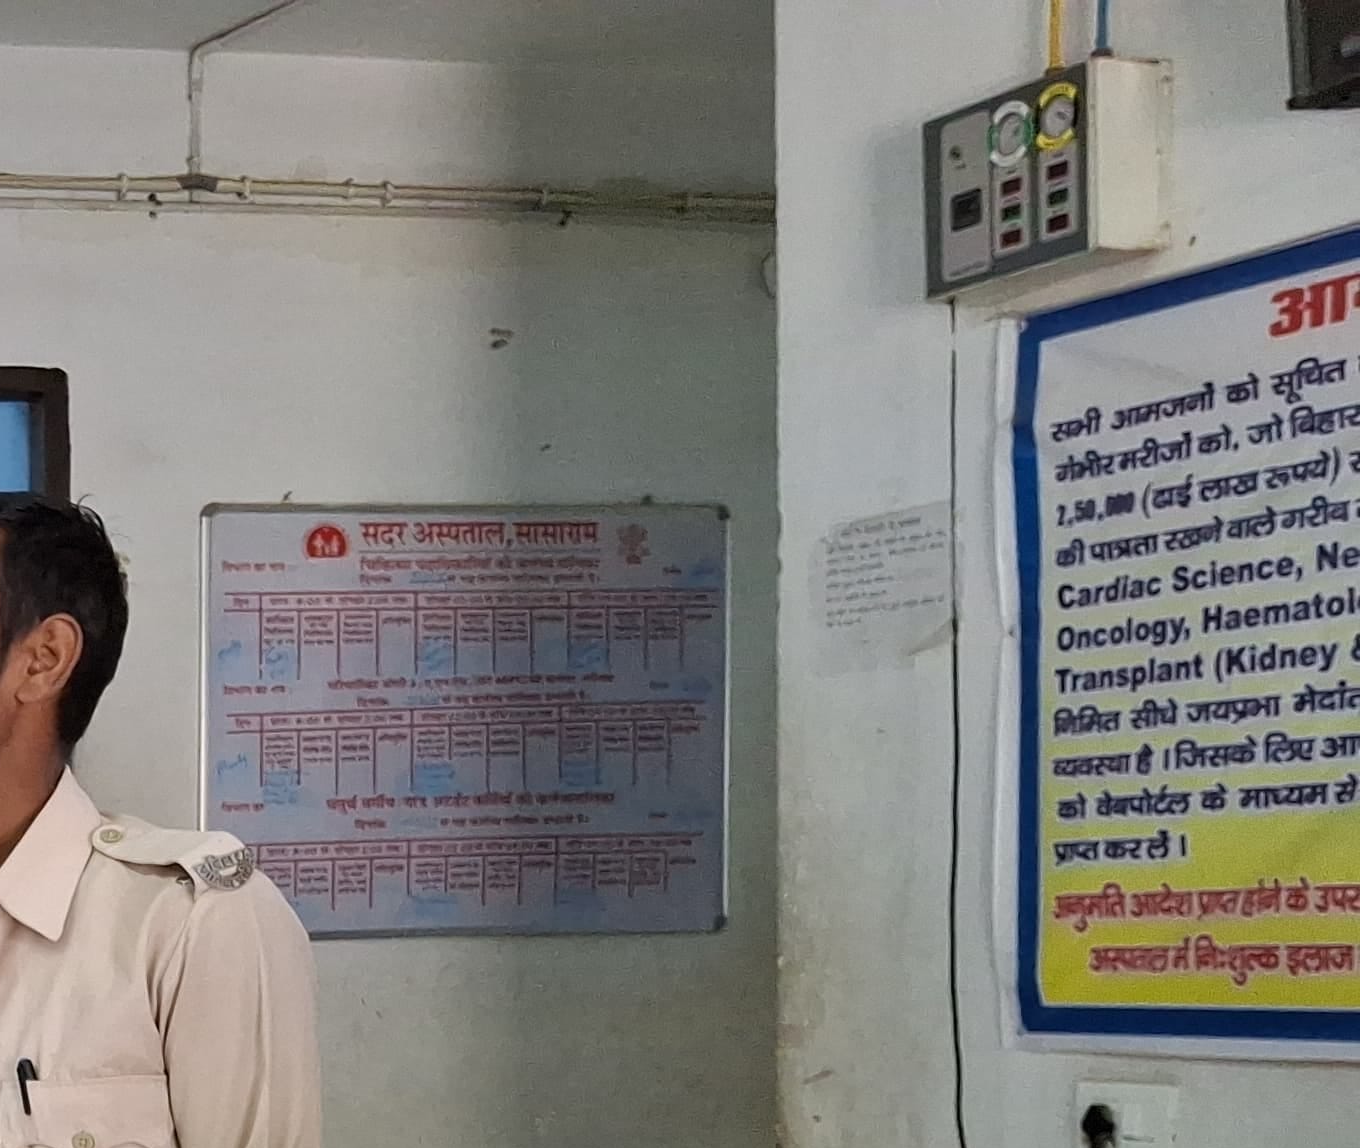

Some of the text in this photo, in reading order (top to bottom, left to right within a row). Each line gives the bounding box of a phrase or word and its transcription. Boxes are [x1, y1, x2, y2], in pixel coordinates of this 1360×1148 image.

[1269, 273, 1360, 338] आ
[1050, 357, 1347, 442] सभी आमजनों को सूचित
[1246, 413, 1282, 444] जो
[1200, 471, 1258, 501] लाख
[360, 521, 407, 547] सदर
[513, 521, 600, 547] सासाराम
[1056, 538, 1084, 567] की
[1164, 516, 1222, 550] रखने
[1227, 506, 1275, 540] वाले
[1057, 576, 1162, 610] Cardiac
[1172, 556, 1303, 593] Science,
[1057, 587, 1360, 651] Oncology, Haematol
[1054, 652, 1203, 694] Transplant
[1215, 642, 1338, 683] (Kidney
[1174, 735, 1256, 769] जिसके
[1265, 732, 1315, 763] लिए
[1058, 792, 1085, 818] को
[1200, 783, 1226, 810] के
[1239, 783, 1328, 808] माध्यम
[1335, 773, 1357, 803] से
